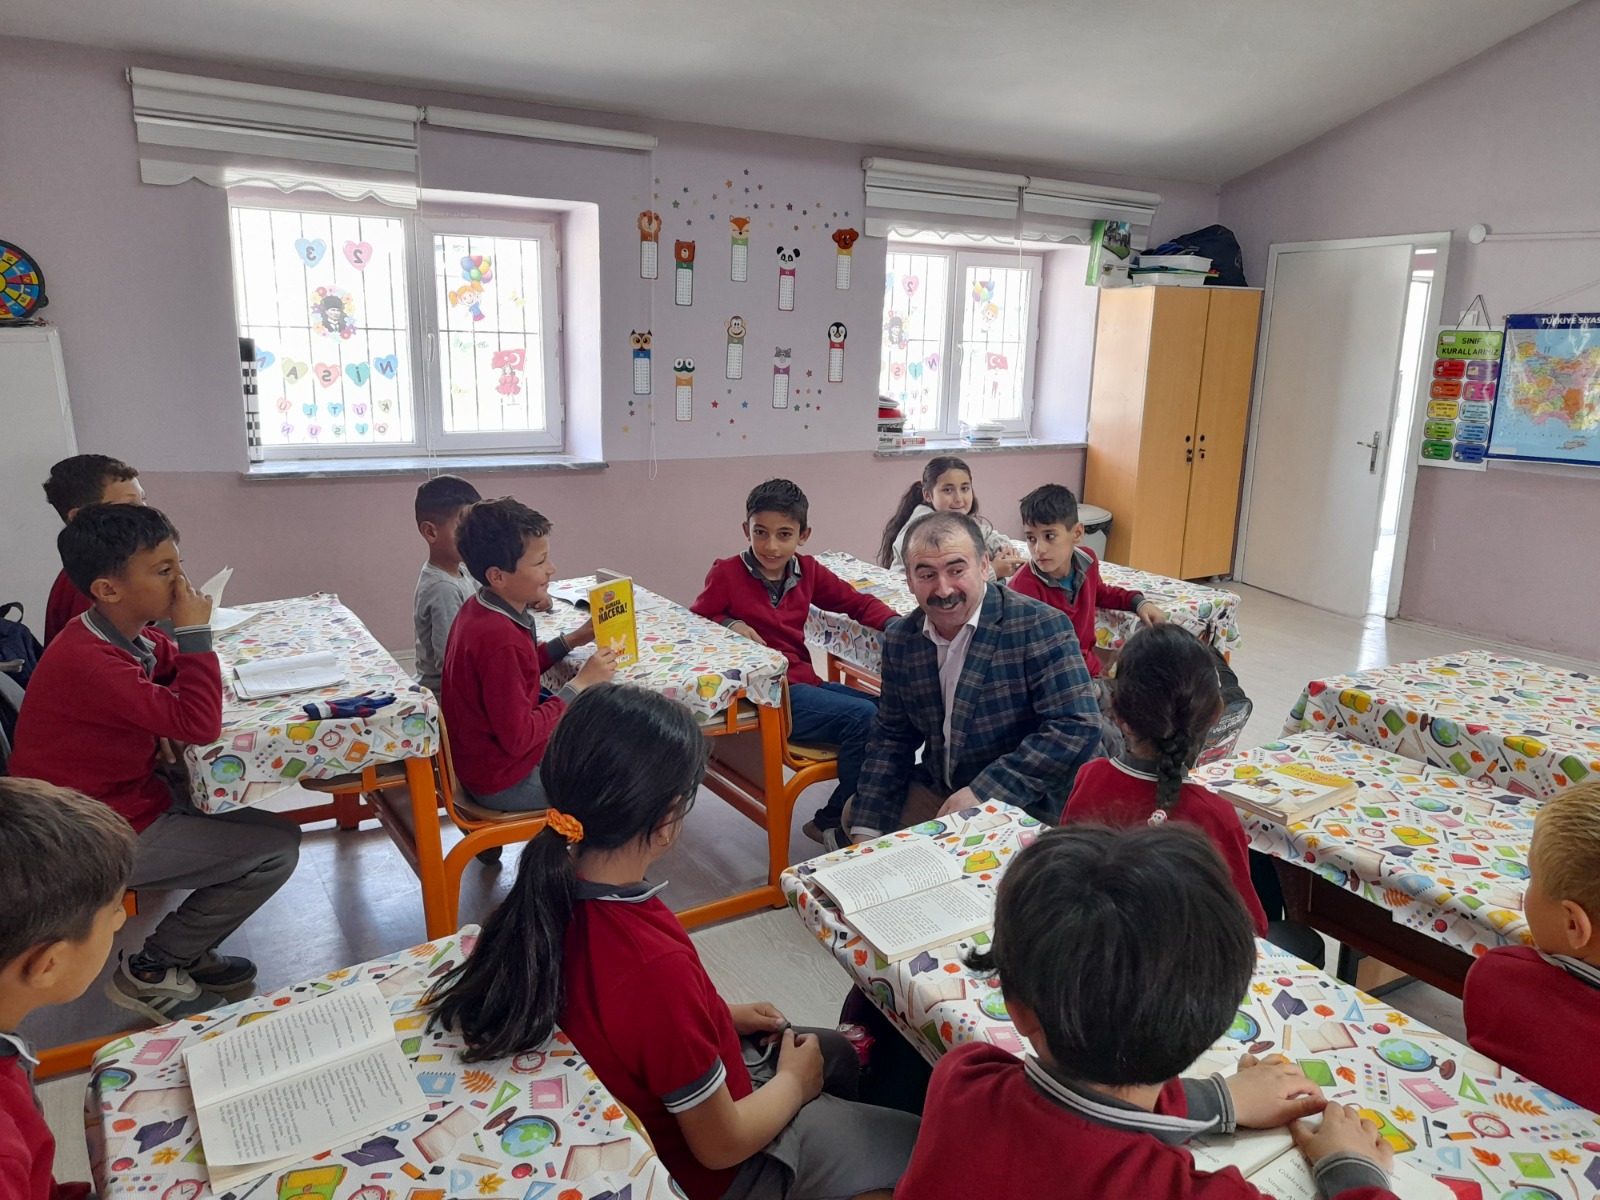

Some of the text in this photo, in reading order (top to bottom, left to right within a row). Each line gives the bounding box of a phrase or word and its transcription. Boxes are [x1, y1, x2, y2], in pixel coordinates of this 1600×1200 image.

[1461, 337, 1483, 345] SINIF
[1441, 347, 1499, 356] KURALLARIMIZ
[598, 602, 628, 624] MACERA!
